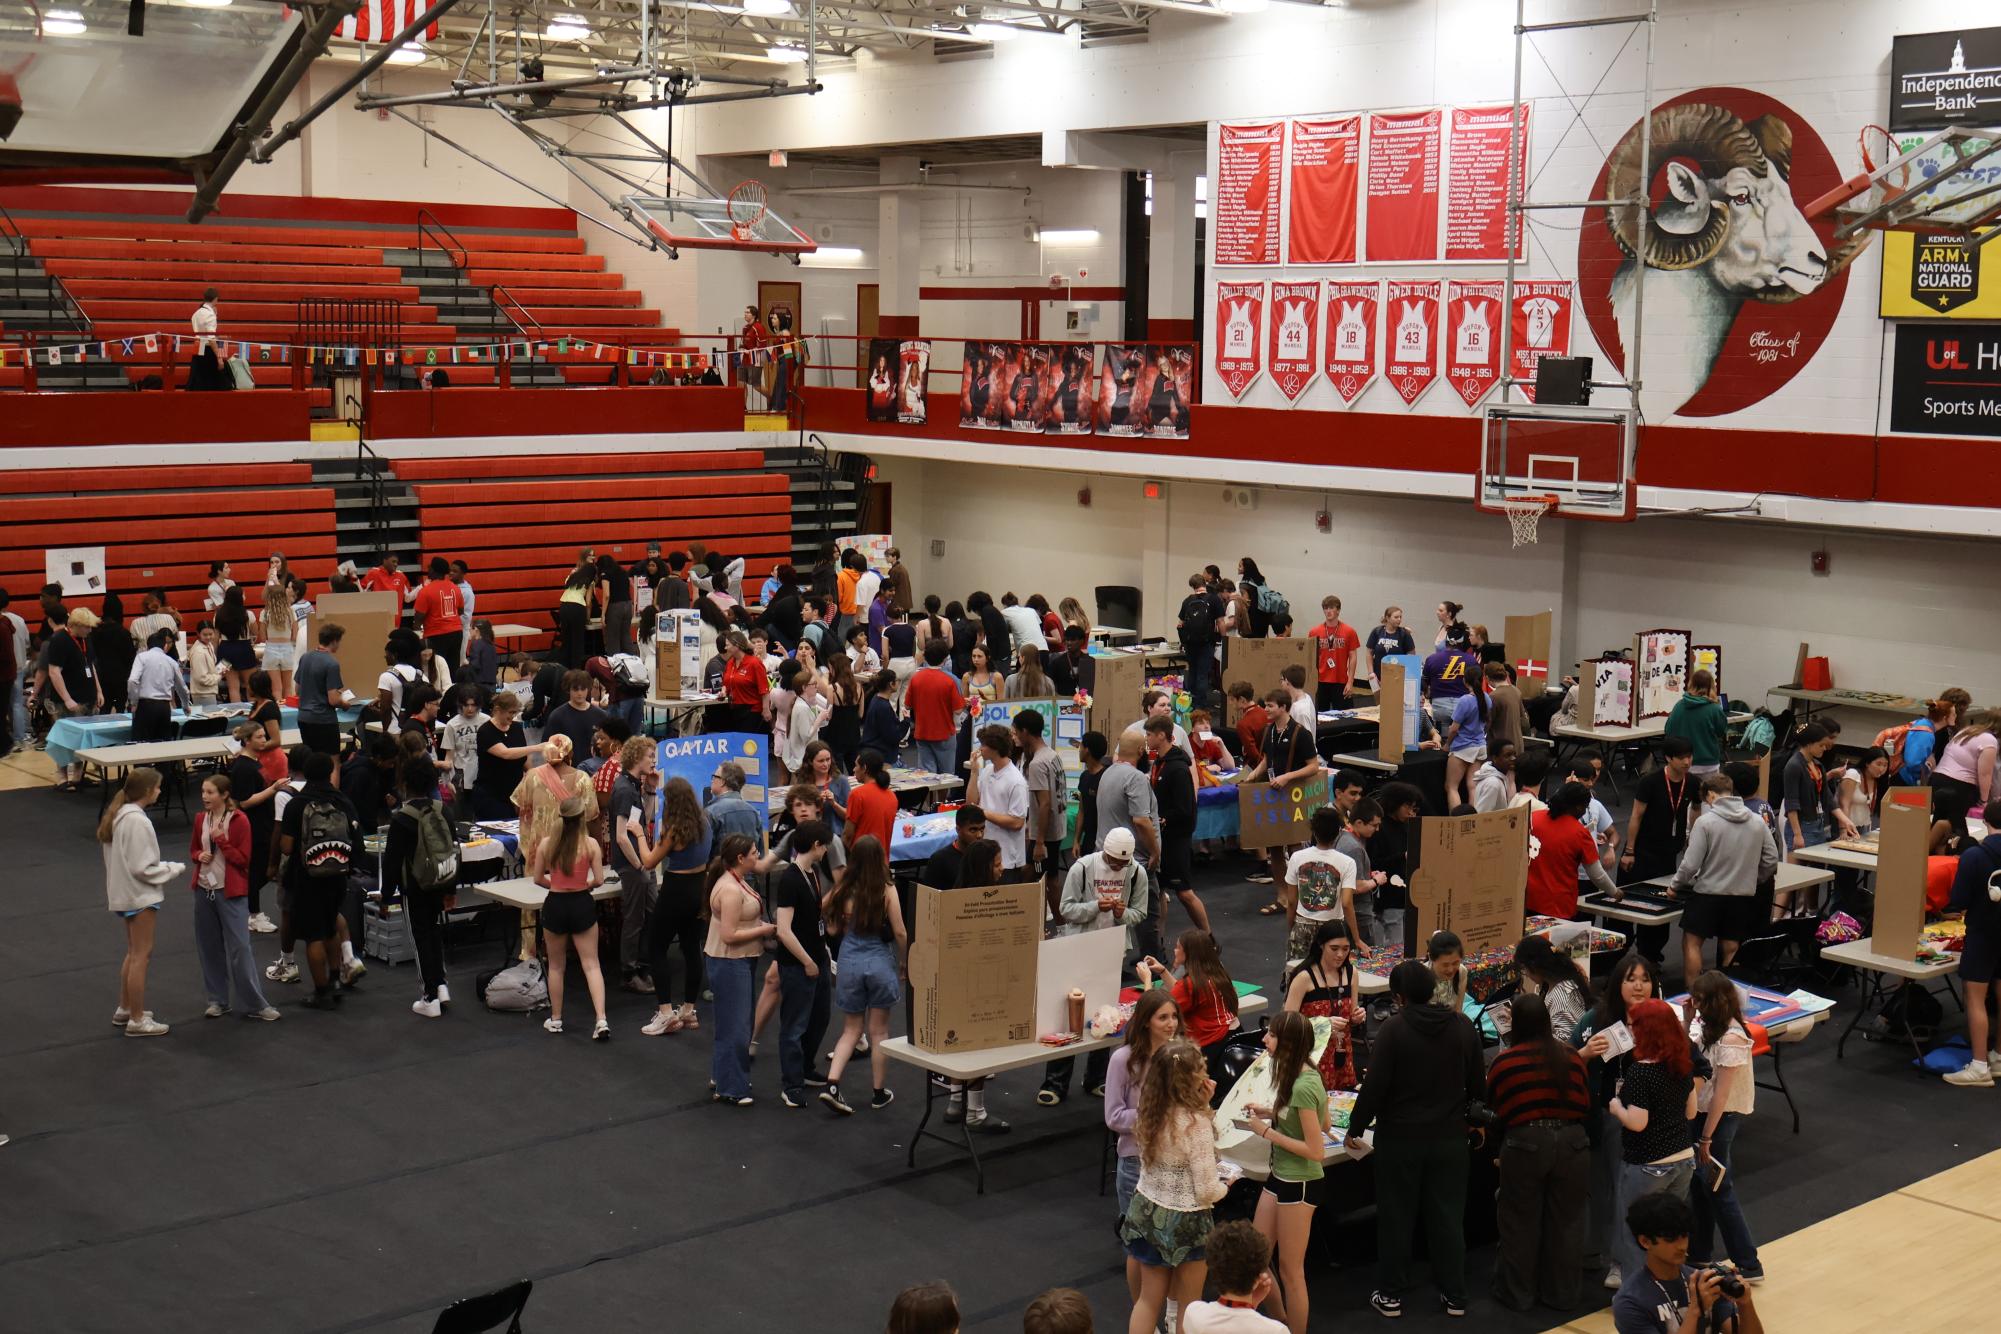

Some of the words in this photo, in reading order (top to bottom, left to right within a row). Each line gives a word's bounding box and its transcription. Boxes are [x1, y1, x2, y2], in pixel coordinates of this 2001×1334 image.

[1935, 93, 1976, 110] Bank
[1387, 120, 1424, 129] manual
[1470, 113, 1510, 123] manual
[1920, 248, 1970, 262] ARMY
[1919, 264, 1972, 273] NATIONAL
[1918, 274, 1972, 288] GUARD
[1220, 286, 1243, 302] PHILLIP
[1244, 286, 1262, 303] BOND
[1275, 286, 1290, 302] GINA
[1292, 286, 1316, 302] BROWN
[1329, 286, 1340, 301] PHIL
[1340, 286, 1378, 302] GRAWEMEYER
[1389, 286, 1412, 302] GWEN
[1415, 286, 1441, 302] DOYLE
[1449, 286, 1462, 302] DON
[1463, 285, 1504, 302] WHITEHOUSE
[1514, 285, 1531, 300] NYA
[1533, 285, 1571, 299] BUNTON
[1234, 330, 1244, 342] 21
[1287, 330, 1301, 342] 44
[1346, 331, 1356, 343] 18
[1405, 332, 1419, 344] 43
[1468, 333, 1480, 345] 16
[1750, 331, 1785, 348] Class
[1787, 331, 1800, 357] of
[1516, 350, 1530, 359] MISS
[1757, 349, 1778, 364] 1981
[1977, 342, 2001, 371] H
[1220, 362, 1235, 370] 1969
[1240, 362, 1254, 371] 1972
[1274, 363, 1291, 372] 1977
[1296, 364, 1310, 373] 1981
[1329, 364, 1346, 373] 1949
[1352, 365, 1368, 374] 1952
[1390, 366, 1408, 376] 1986
[1414, 366, 1430, 376] 1990
[1451, 368, 1471, 377] 1948
[1476, 368, 1493, 377] 1951
[1924, 397, 1975, 418] Sports
[1595, 669, 1613, 689] VIA
[984, 704, 1058, 722] SOLOON
[666, 739, 728, 758] QATAR
